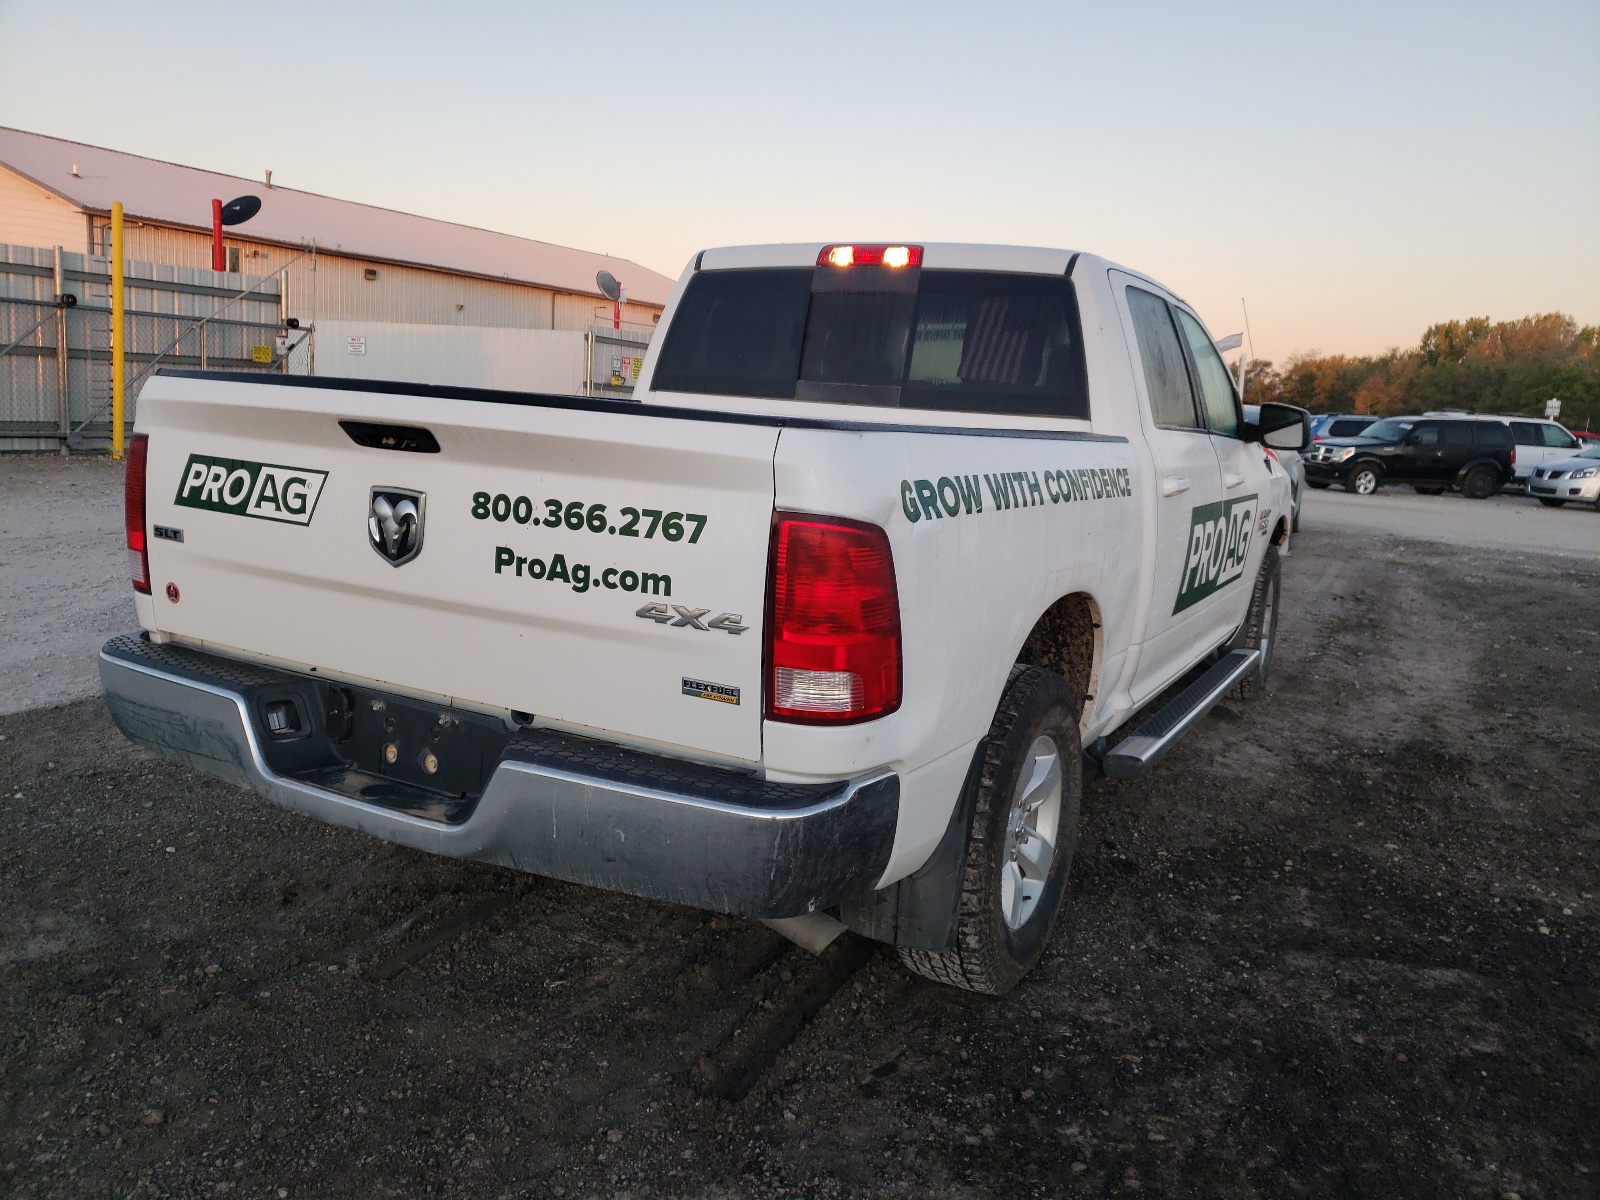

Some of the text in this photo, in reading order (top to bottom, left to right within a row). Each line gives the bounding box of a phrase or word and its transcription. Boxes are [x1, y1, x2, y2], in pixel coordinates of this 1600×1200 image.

[470, 491, 708, 544] 800.366.2767
[900, 467, 1132, 524] GROW WITH CONFIDENCE
[154, 527, 180, 540] SLT
[494, 546, 672, 597] ProAg.com
